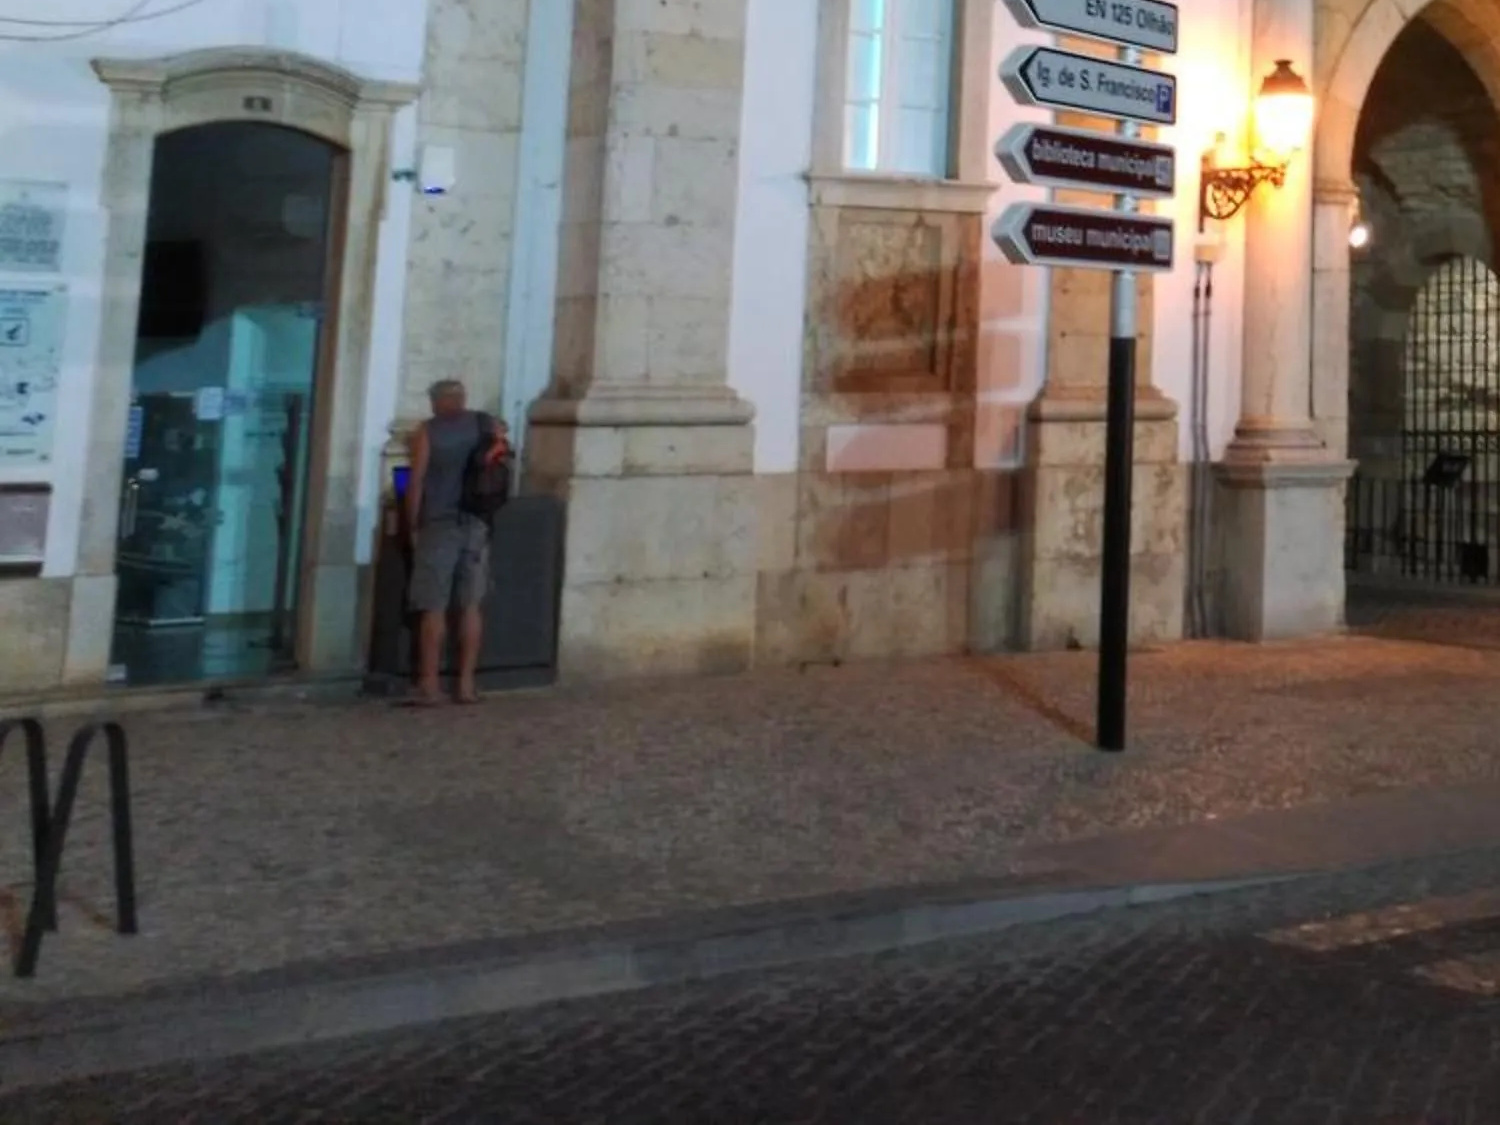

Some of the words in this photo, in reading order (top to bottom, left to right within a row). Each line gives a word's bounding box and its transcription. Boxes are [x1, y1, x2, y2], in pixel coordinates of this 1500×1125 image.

[1111, 2, 1133, 26] 125
[1058, 65, 1075, 89] de
[1079, 69, 1093, 92] S.
[1097, 73, 1155, 103] Francisco
[1032, 137, 1095, 170] biblioteca
[1032, 222, 1083, 246] museu
